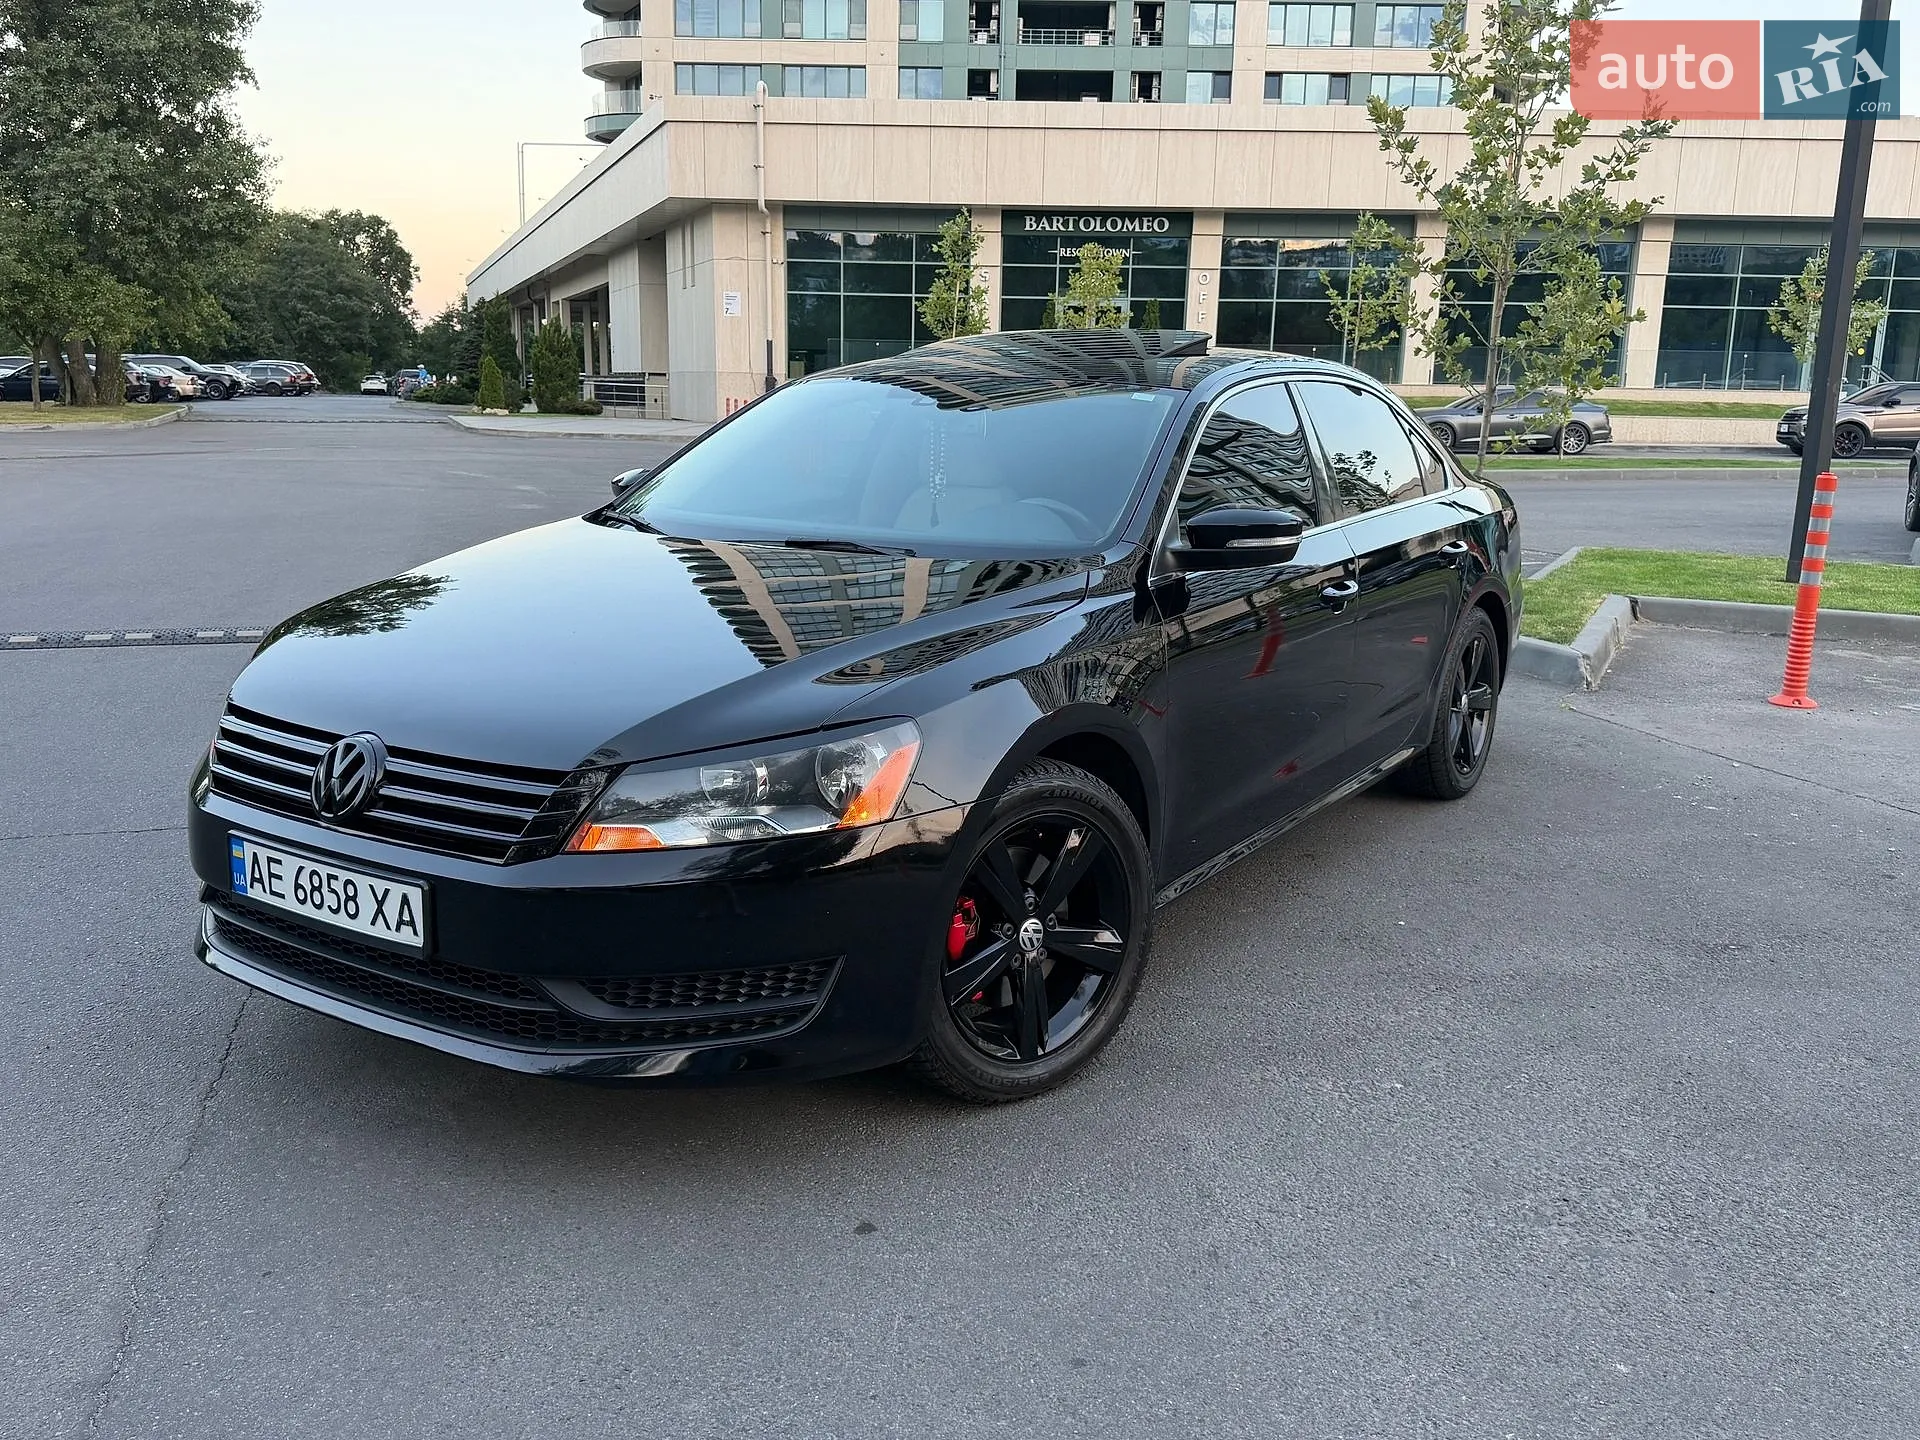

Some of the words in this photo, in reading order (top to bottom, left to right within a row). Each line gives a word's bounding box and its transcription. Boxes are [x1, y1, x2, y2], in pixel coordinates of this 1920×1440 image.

[1024, 215, 1170, 233] BARTOLOMEO
[233, 872, 247, 886] UA
[249, 851, 286, 900] AE
[293, 865, 361, 920] 6858
[368, 883, 419, 937] XA
